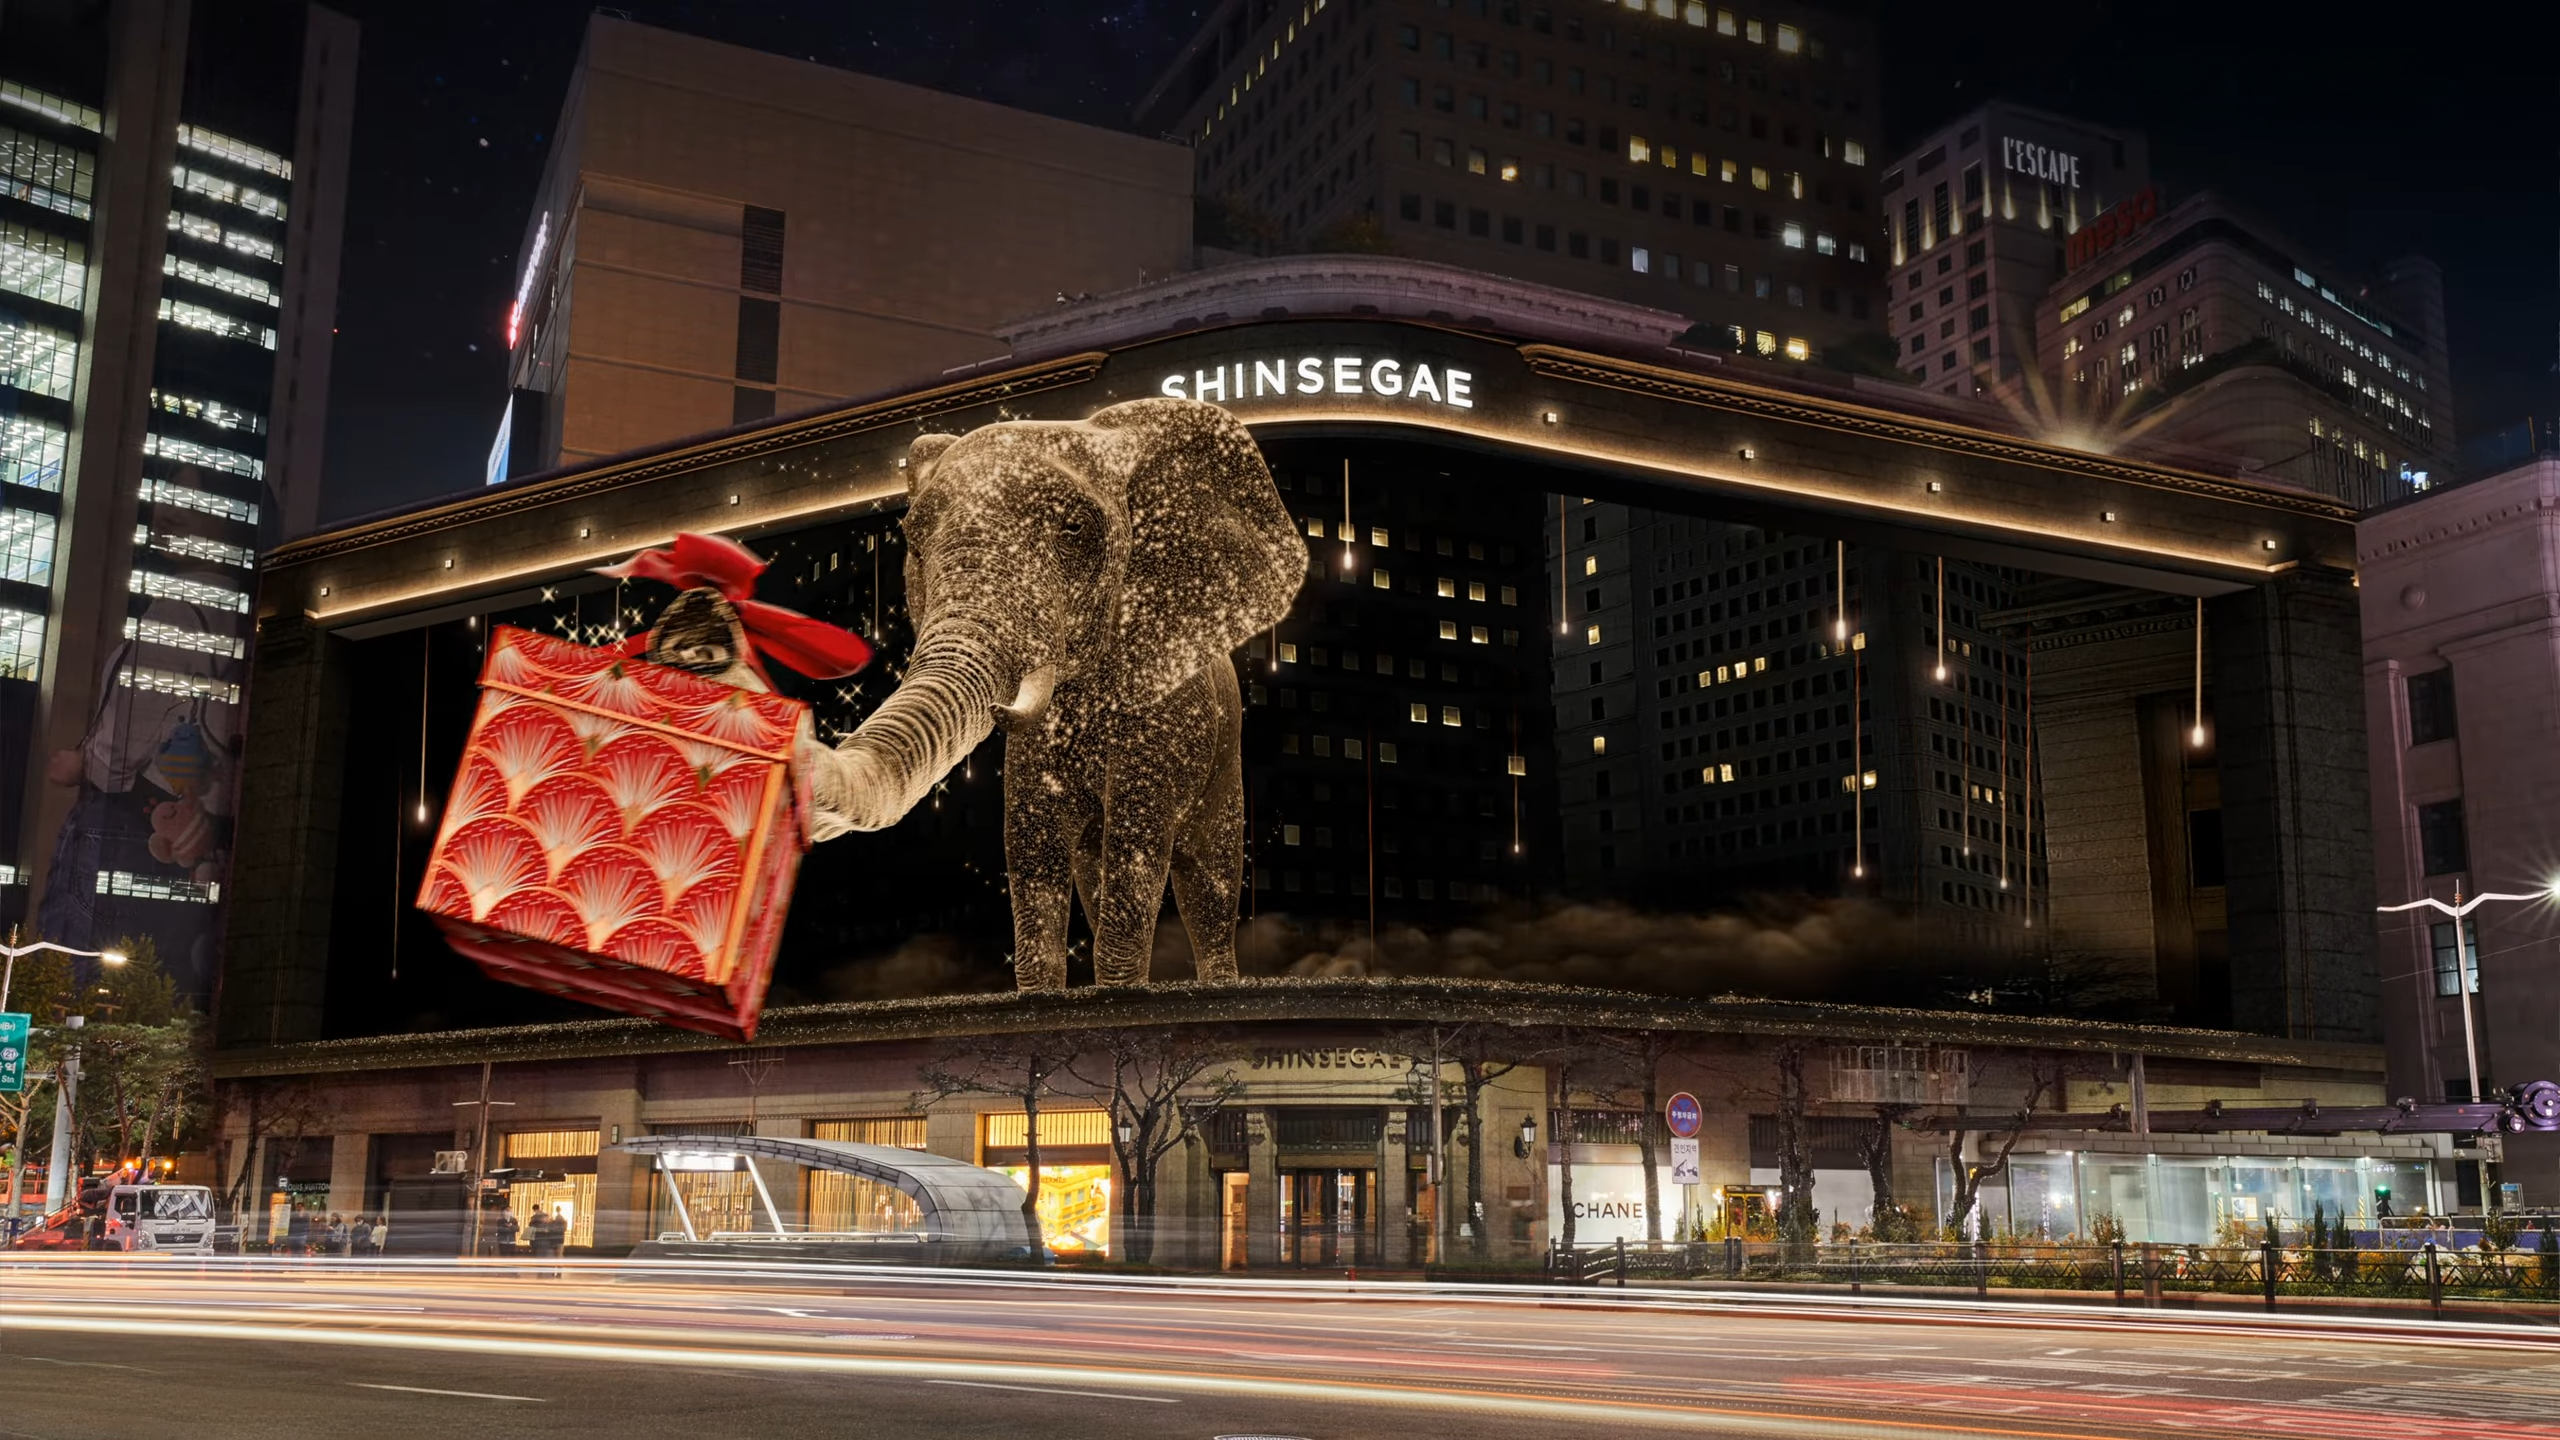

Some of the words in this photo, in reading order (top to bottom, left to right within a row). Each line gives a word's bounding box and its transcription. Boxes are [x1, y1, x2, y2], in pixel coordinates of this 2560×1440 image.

[2003, 136, 2081, 188] L'ESCAPE
[1161, 357, 1473, 408] SHINSEGAE
[1251, 1047, 1401, 1069] SHINSEGAE
[1, 1074, 15, 1083] Stn
[1673, 1143, 1697, 1154] 견인지역
[1574, 1202, 1643, 1219] CHANE
